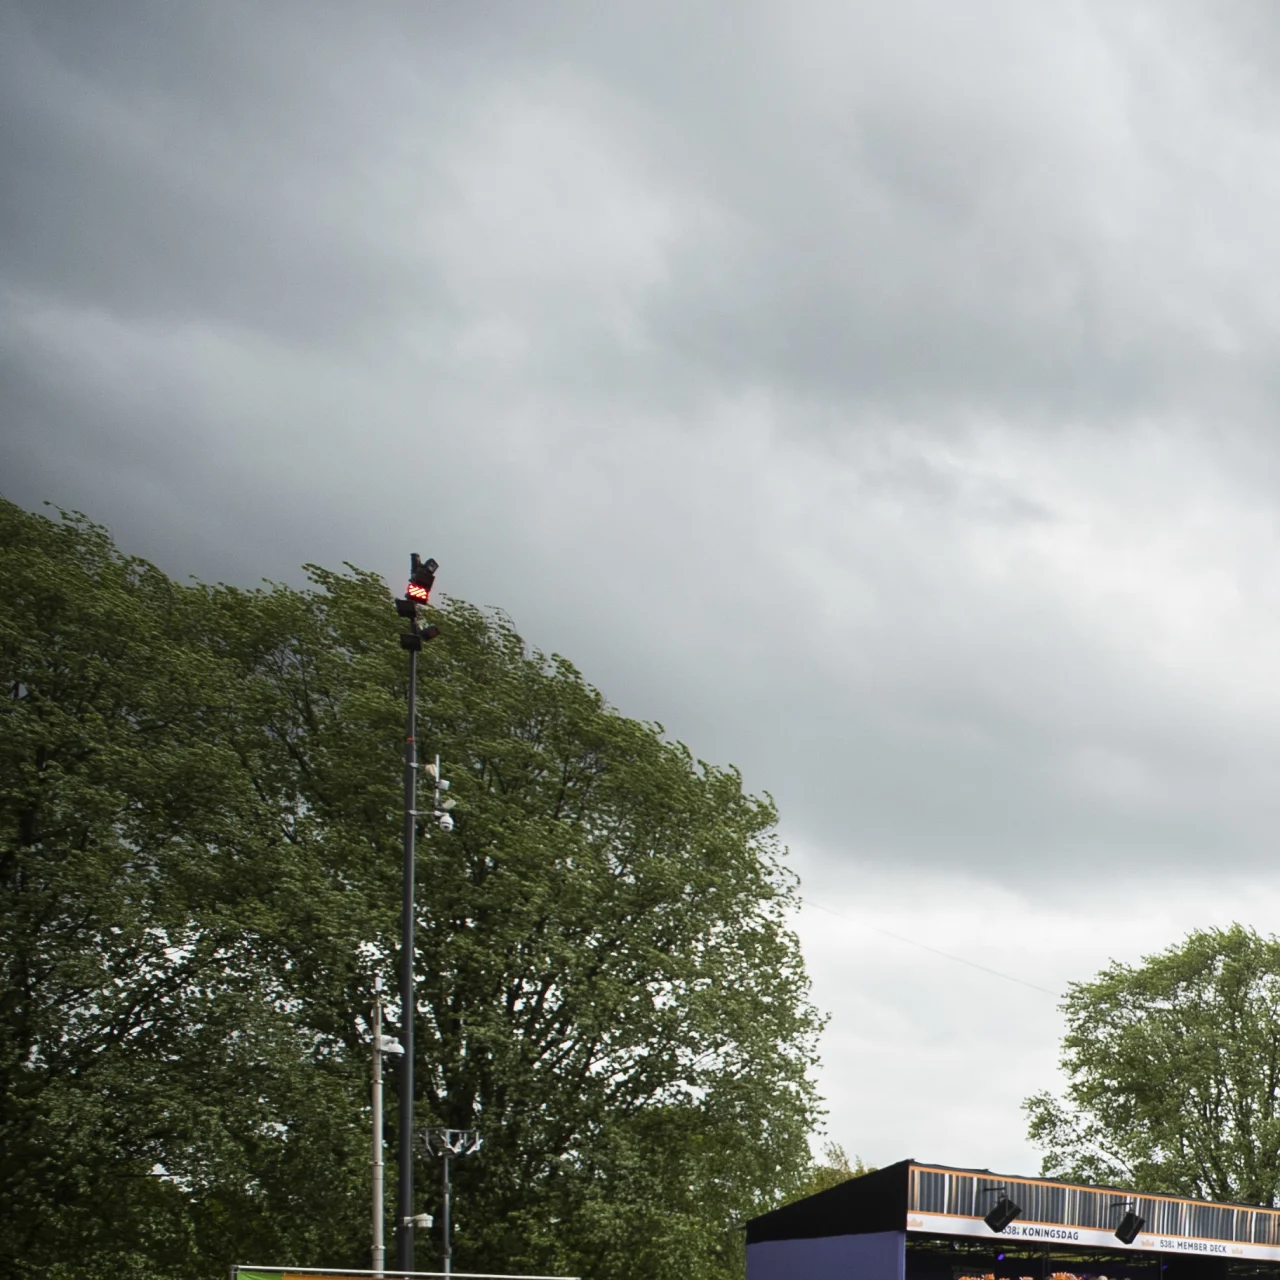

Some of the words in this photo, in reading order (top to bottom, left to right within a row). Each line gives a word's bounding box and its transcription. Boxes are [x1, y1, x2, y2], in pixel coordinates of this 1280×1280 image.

[1022, 1227, 1079, 1240] KONINGSDAG
[1177, 1241, 1207, 1251] MEMBER
[1209, 1245, 1226, 1253] DECK
